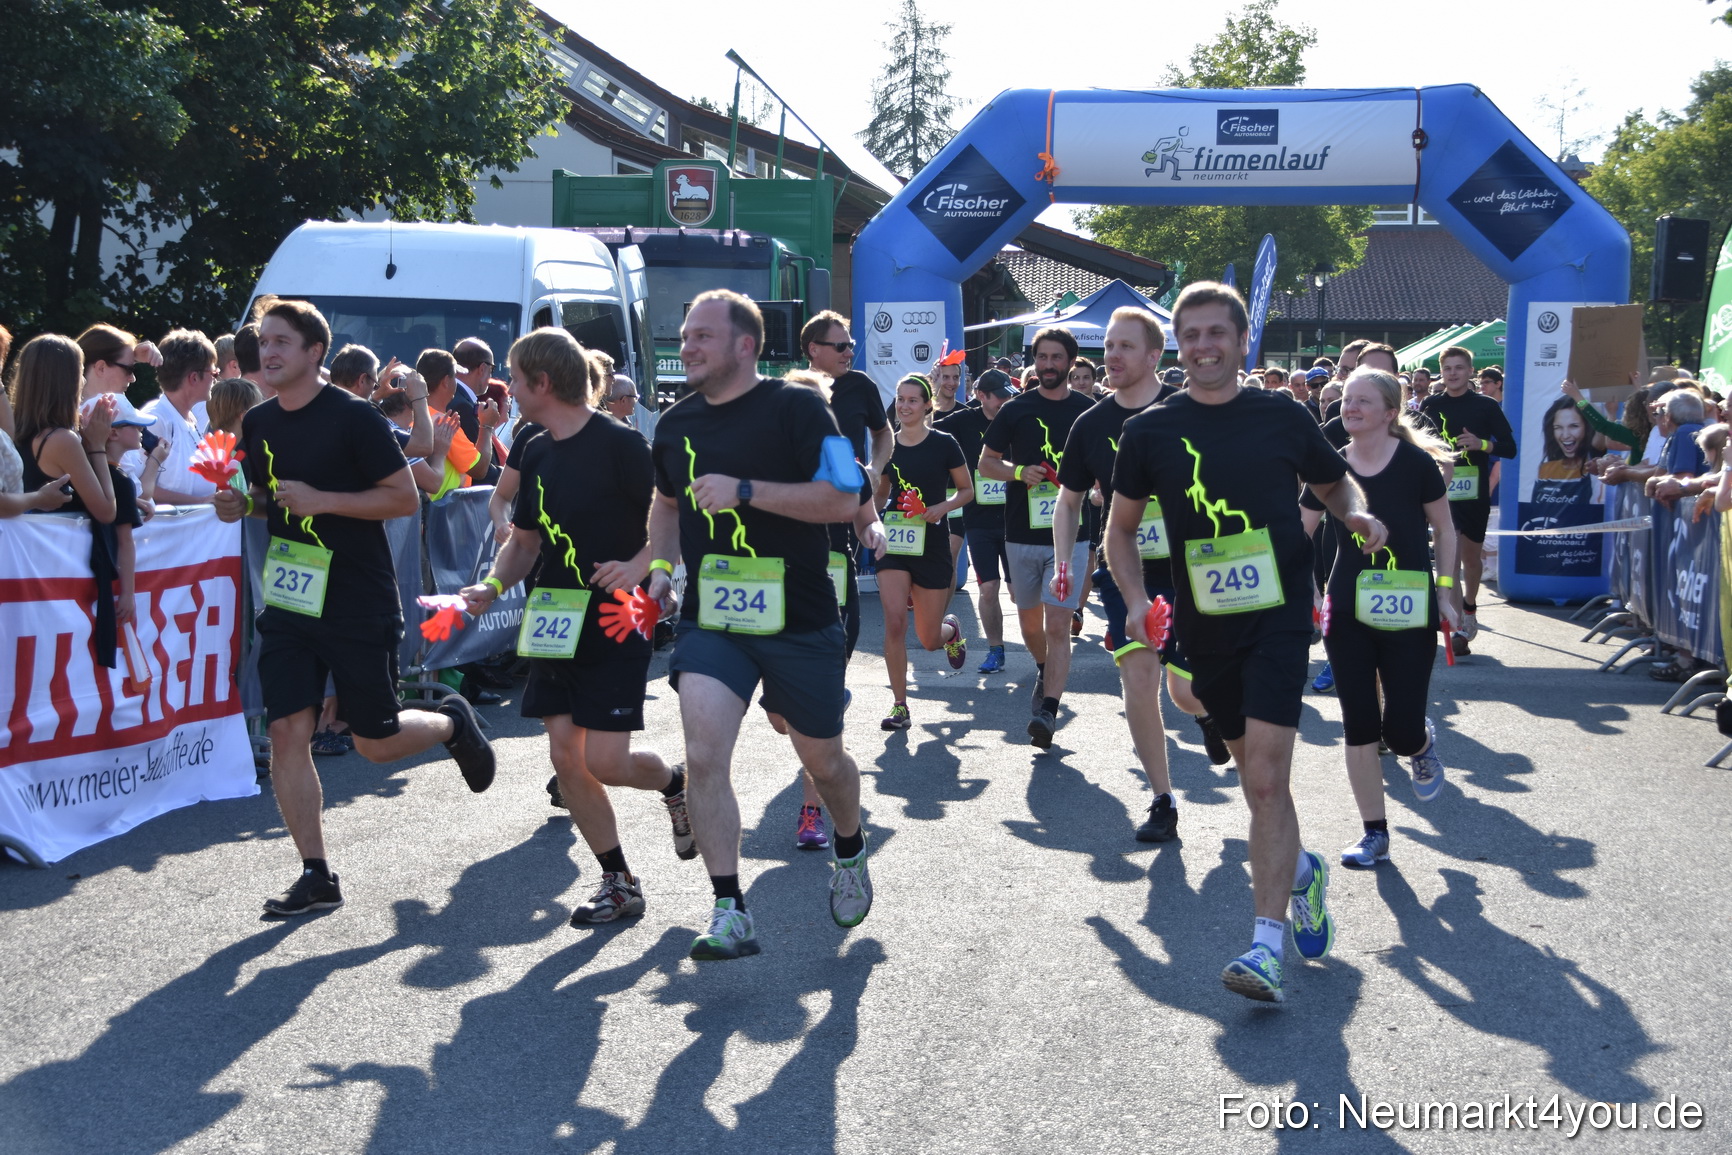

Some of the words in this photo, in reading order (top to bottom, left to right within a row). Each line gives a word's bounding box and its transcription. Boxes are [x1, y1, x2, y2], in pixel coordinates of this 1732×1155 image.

[1230, 123, 1275, 132] Fischer
[1194, 145, 1331, 171] firmenlauf
[1193, 171, 1249, 181] neumarkt
[937, 195, 1009, 210] Fischer
[1474, 192, 1495, 203] und
[1497, 190, 1517, 200] das
[1518, 188, 1559, 200] Lächeln
[1500, 201, 1528, 215] fährt
[1532, 200, 1555, 209] mit!
[680, 211, 702, 221] 1628
[915, 347, 929, 358] FIAT
[983, 482, 1006, 495] 244
[1447, 479, 1472, 492] 240
[1540, 493, 1578, 504] Fischer
[1040, 500, 1057, 515] 22
[888, 528, 915, 544] 216
[1136, 525, 1160, 546] 54
[274, 566, 314, 594] 237
[1206, 564, 1260, 594] 249
[714, 586, 767, 614] 234
[1369, 594, 1414, 615] 230
[532, 616, 571, 639] 242
